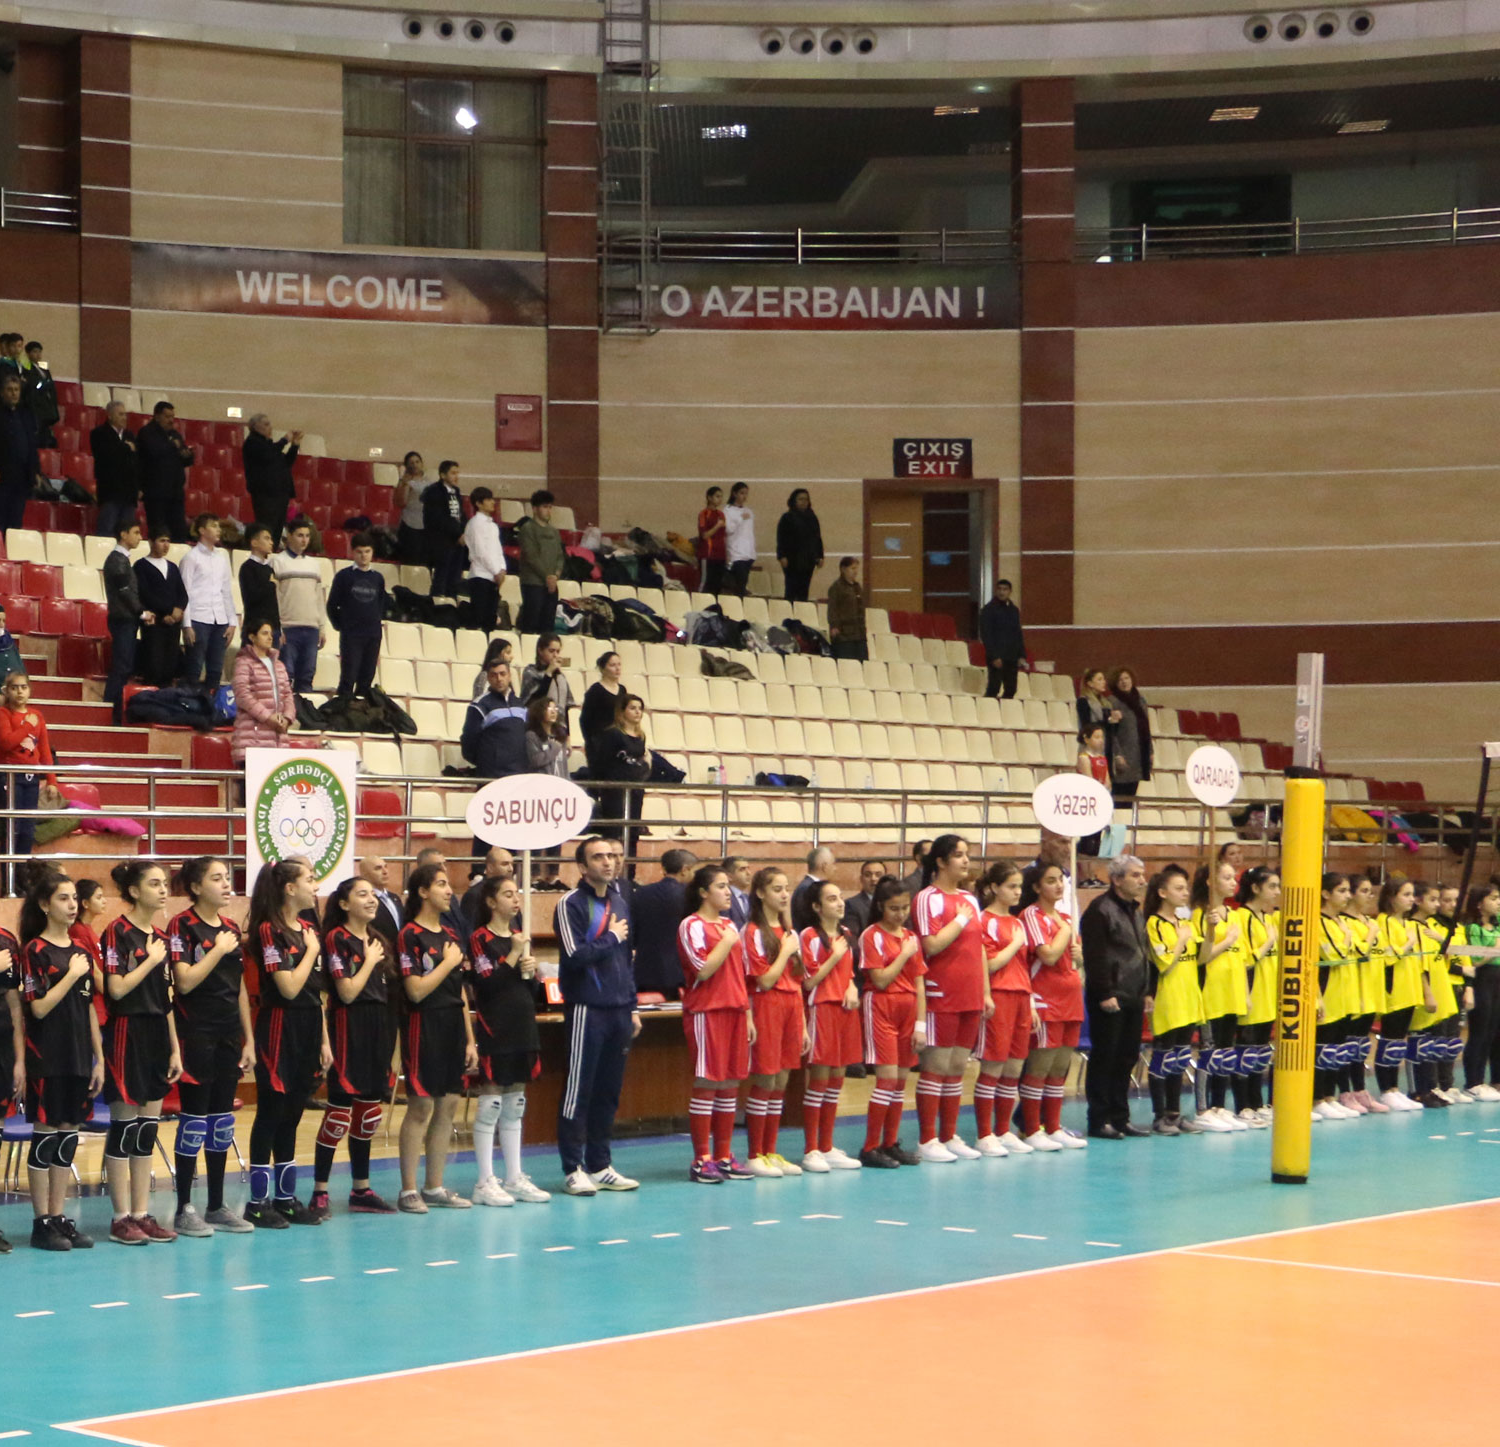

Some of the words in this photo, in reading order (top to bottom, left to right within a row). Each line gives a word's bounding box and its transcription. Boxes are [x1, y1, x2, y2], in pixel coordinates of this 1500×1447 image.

[236, 270, 443, 312] WELCOME
[701, 286, 961, 318] AZERBAIJAN
[977, 287, 985, 317] !
[903, 442, 964, 460] ÇIXIŞ
[908, 461, 959, 475] EXIT
[483, 797, 576, 829] SABUNÇU
[1053, 794, 1097, 816] XƏZƏR
[1278, 918, 1303, 1040] KÜBLER
